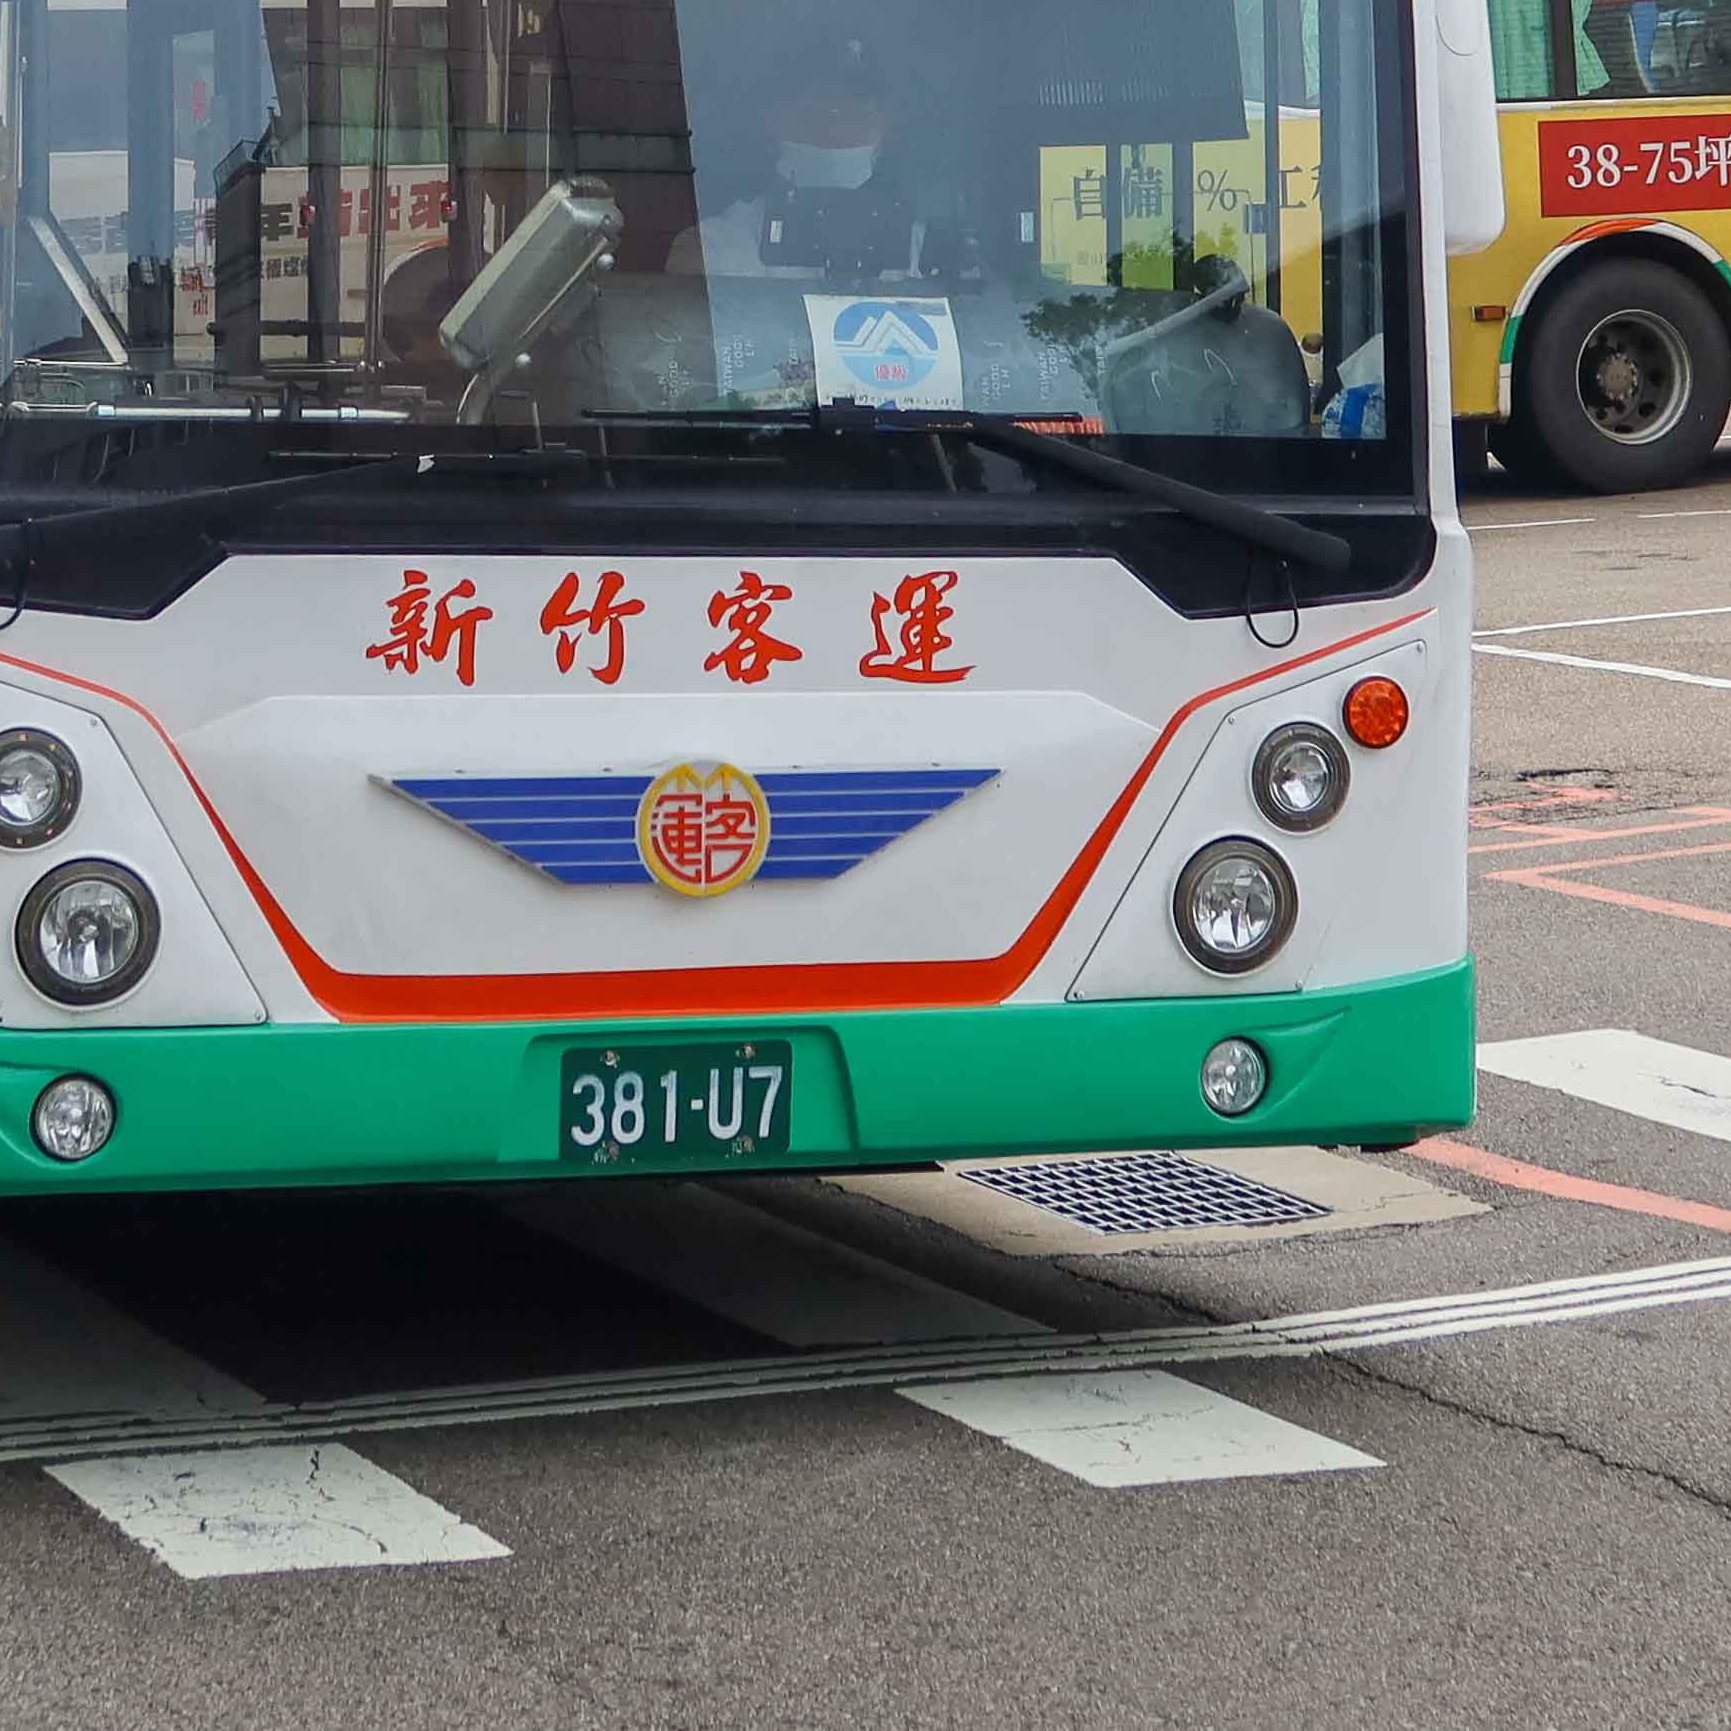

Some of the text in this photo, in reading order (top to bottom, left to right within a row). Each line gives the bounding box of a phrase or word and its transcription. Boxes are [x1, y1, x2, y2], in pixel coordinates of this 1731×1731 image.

[364, 569, 977, 687] 新竹客運
[570, 1065, 784, 1147] 381-U7
